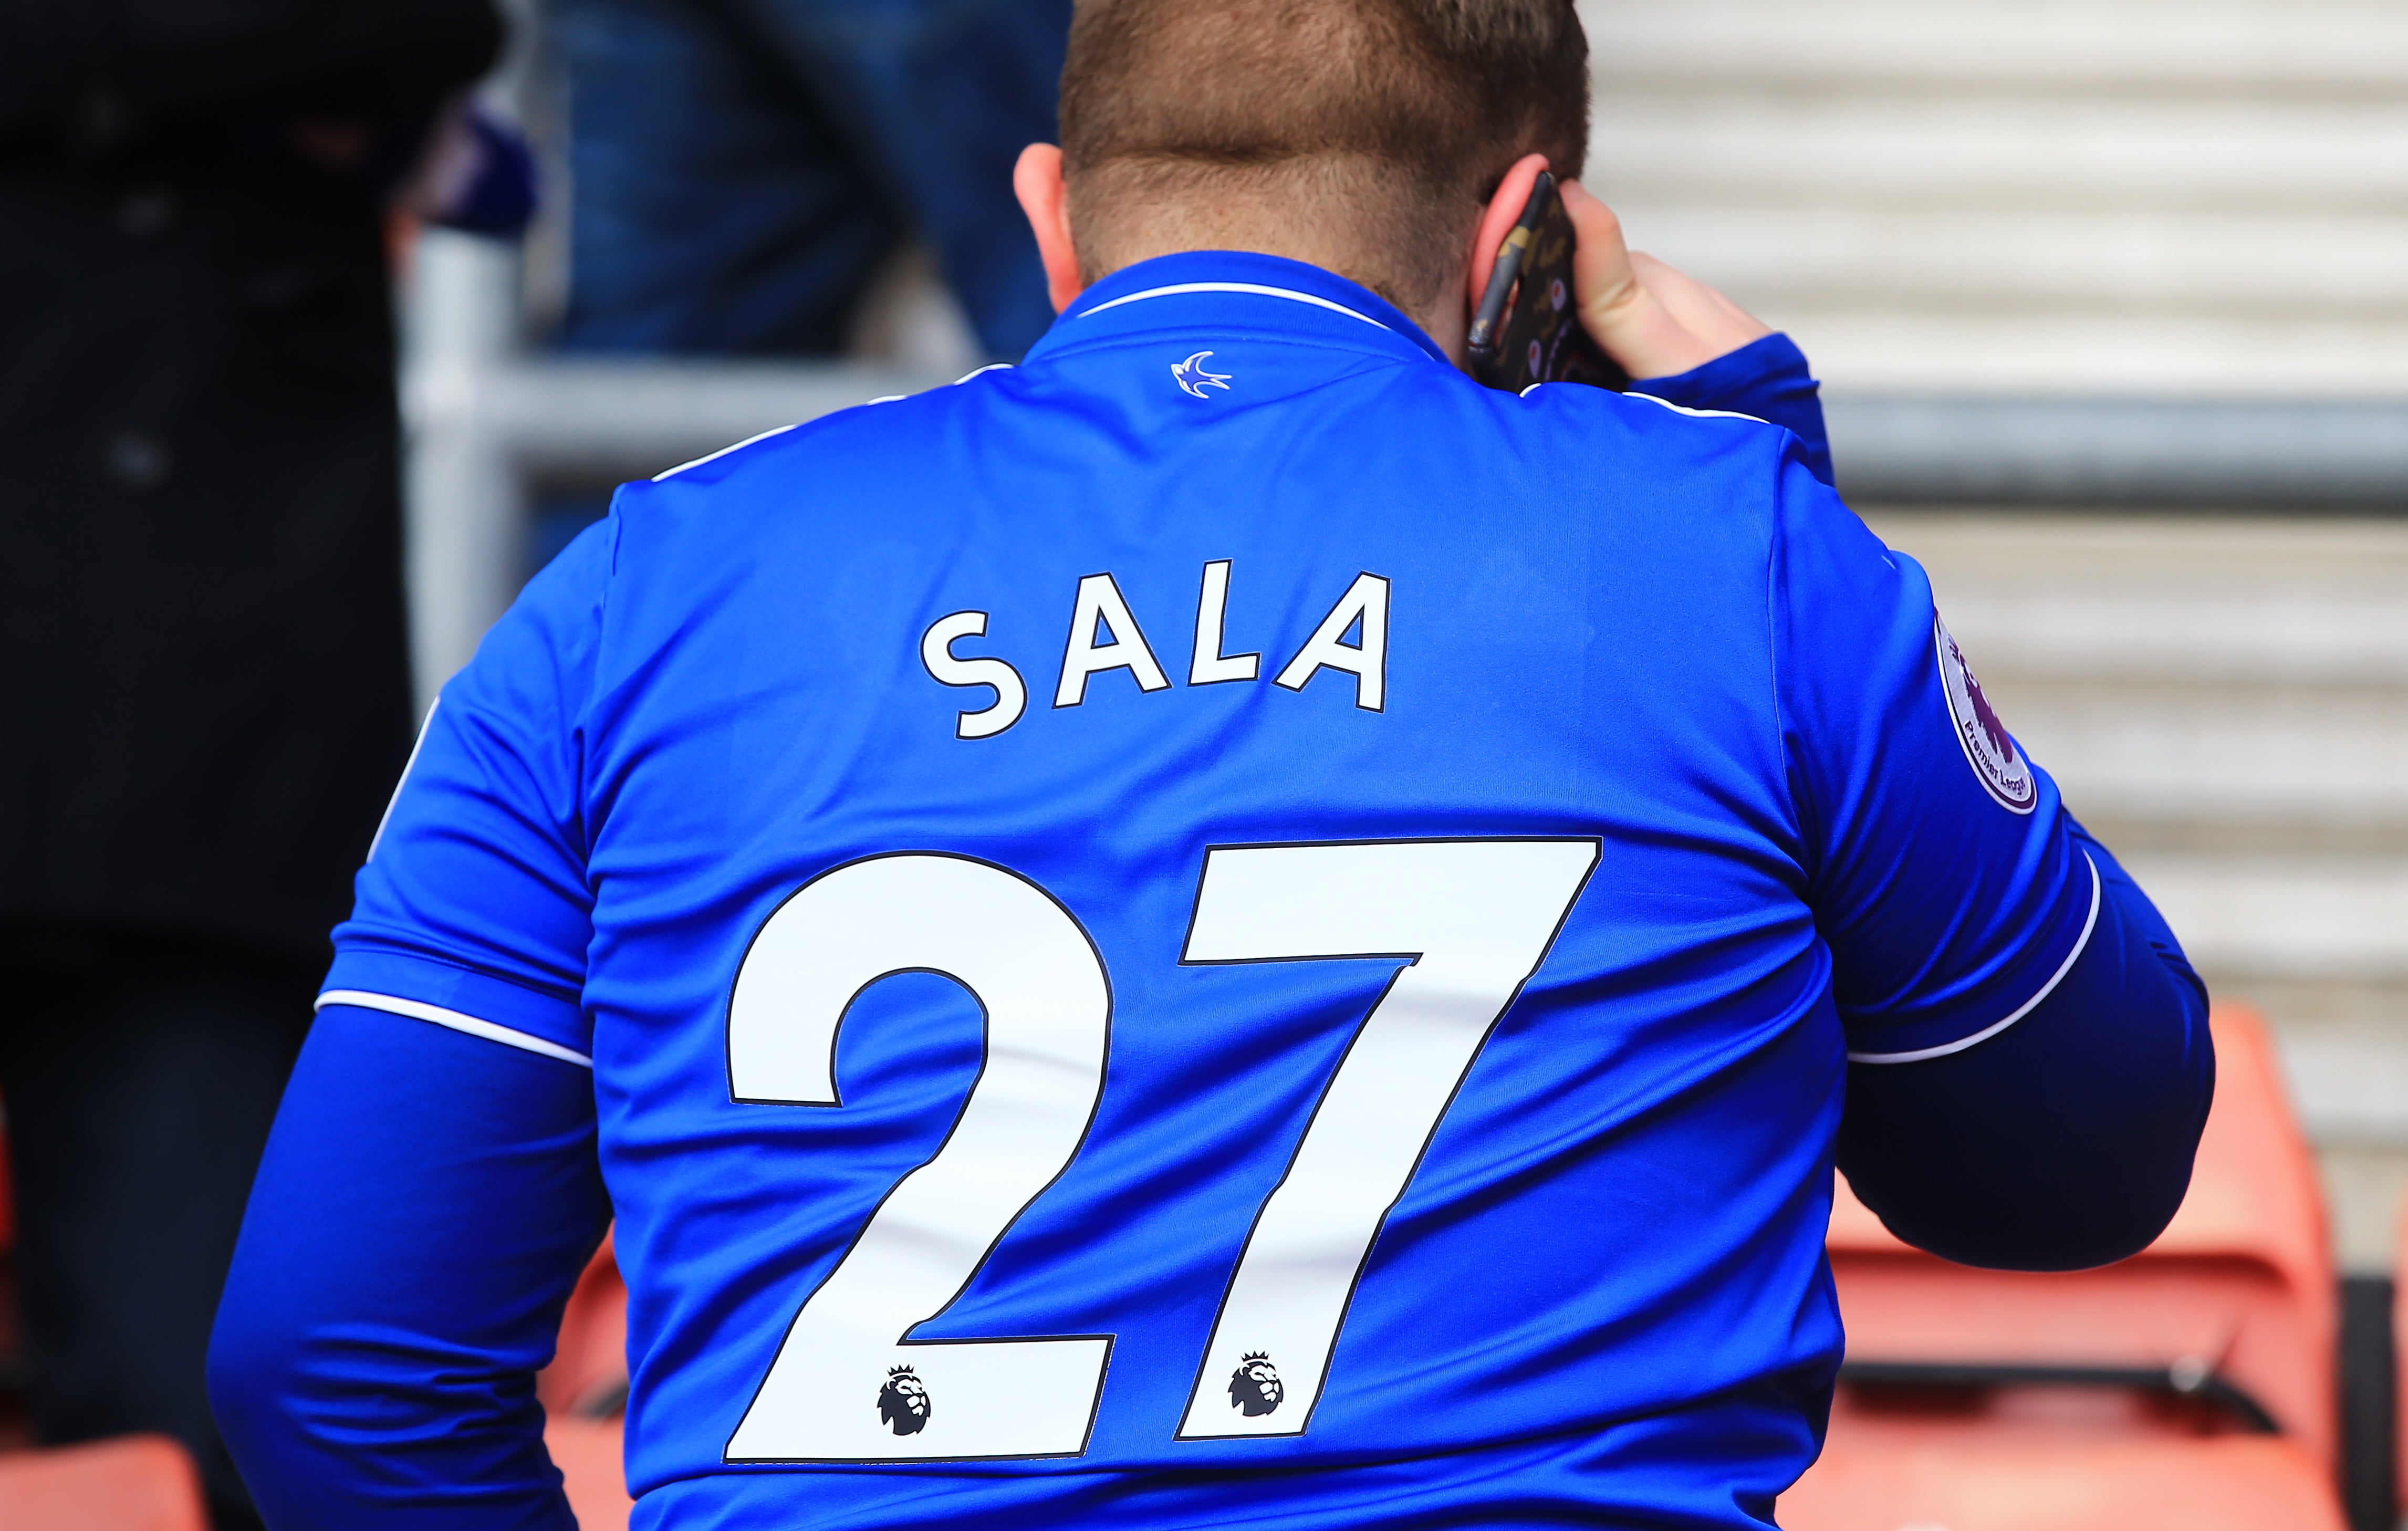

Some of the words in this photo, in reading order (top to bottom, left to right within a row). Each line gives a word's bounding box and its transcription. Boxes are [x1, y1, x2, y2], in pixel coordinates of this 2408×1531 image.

[921, 559, 1391, 740] SALA
[1965, 720, 1998, 779] Premier
[723, 836, 1603, 1464] 27
